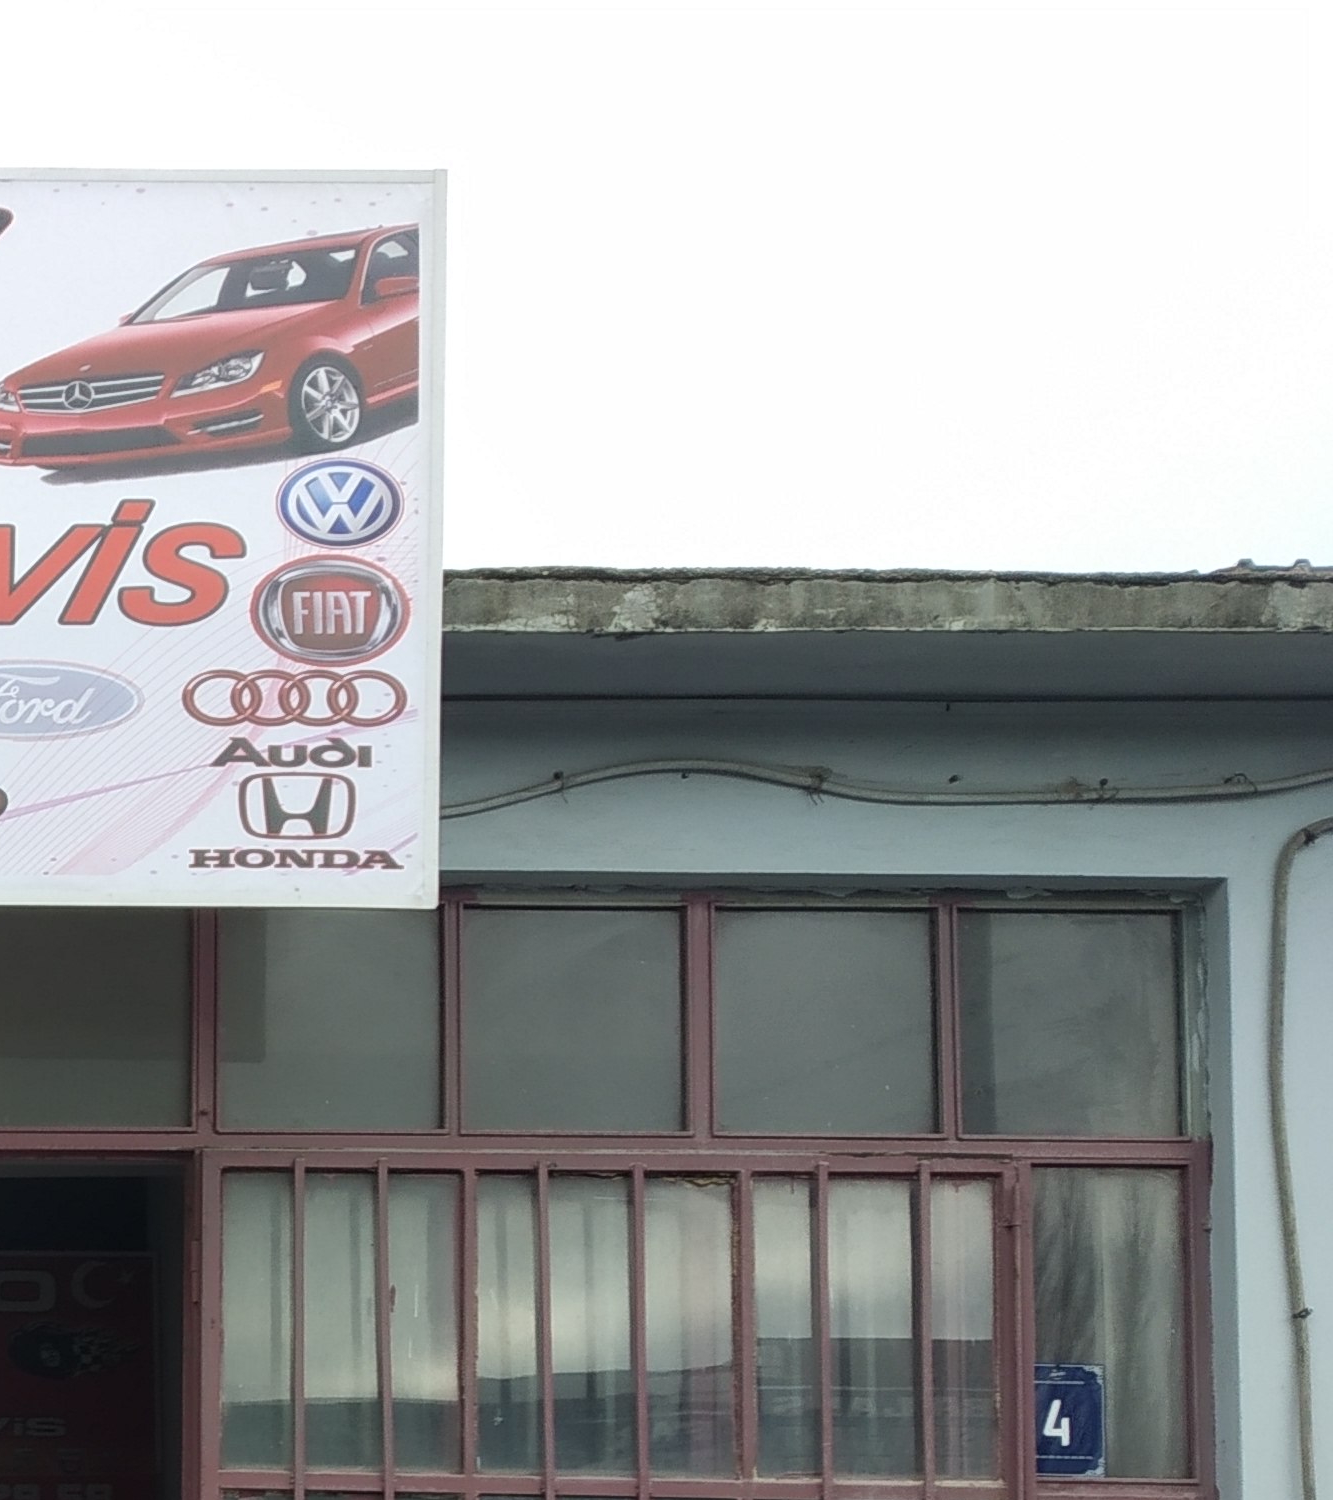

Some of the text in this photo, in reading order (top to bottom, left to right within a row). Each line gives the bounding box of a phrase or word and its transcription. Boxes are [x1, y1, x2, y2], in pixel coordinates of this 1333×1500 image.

[292, 590, 371, 636] FIAT
[188, 849, 404, 870] HONDA
[1043, 1399, 1071, 1447] 4
